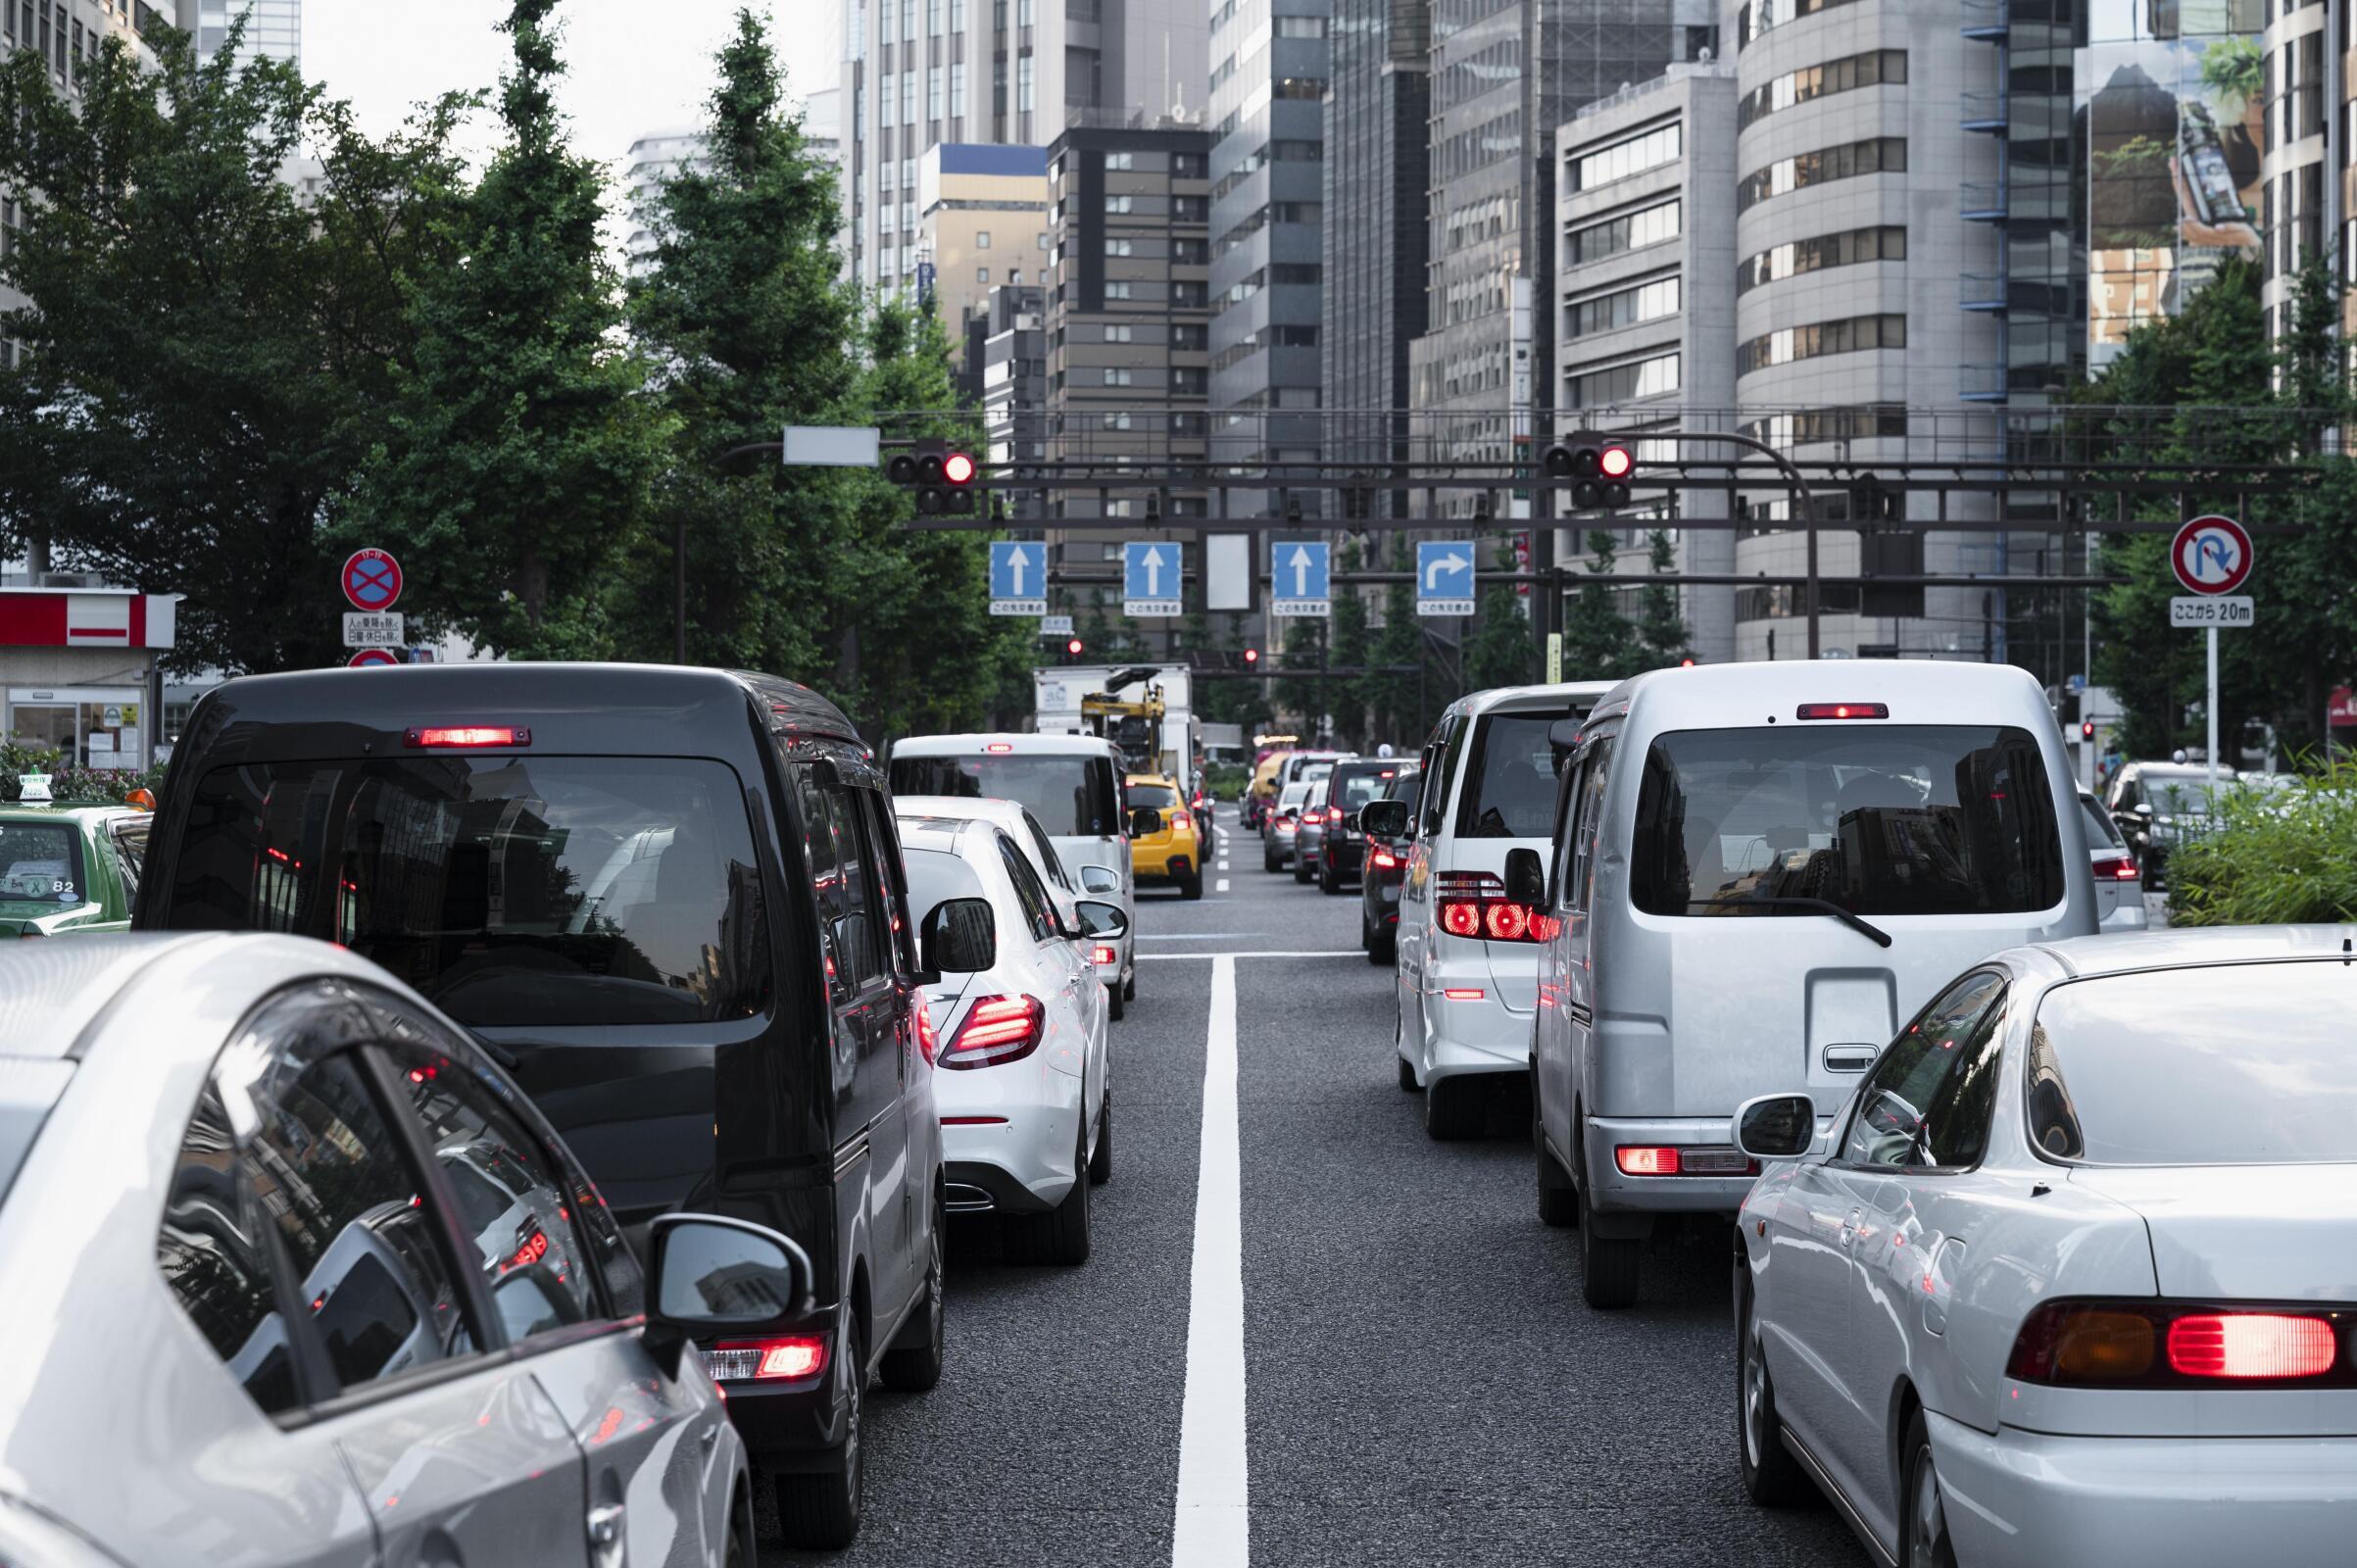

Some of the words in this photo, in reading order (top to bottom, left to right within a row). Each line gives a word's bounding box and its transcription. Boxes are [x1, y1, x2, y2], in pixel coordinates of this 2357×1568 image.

[2175, 604, 2215, 619] ここから
[2219, 603, 2250, 620] 20m
[52, 881, 74, 893] 82
